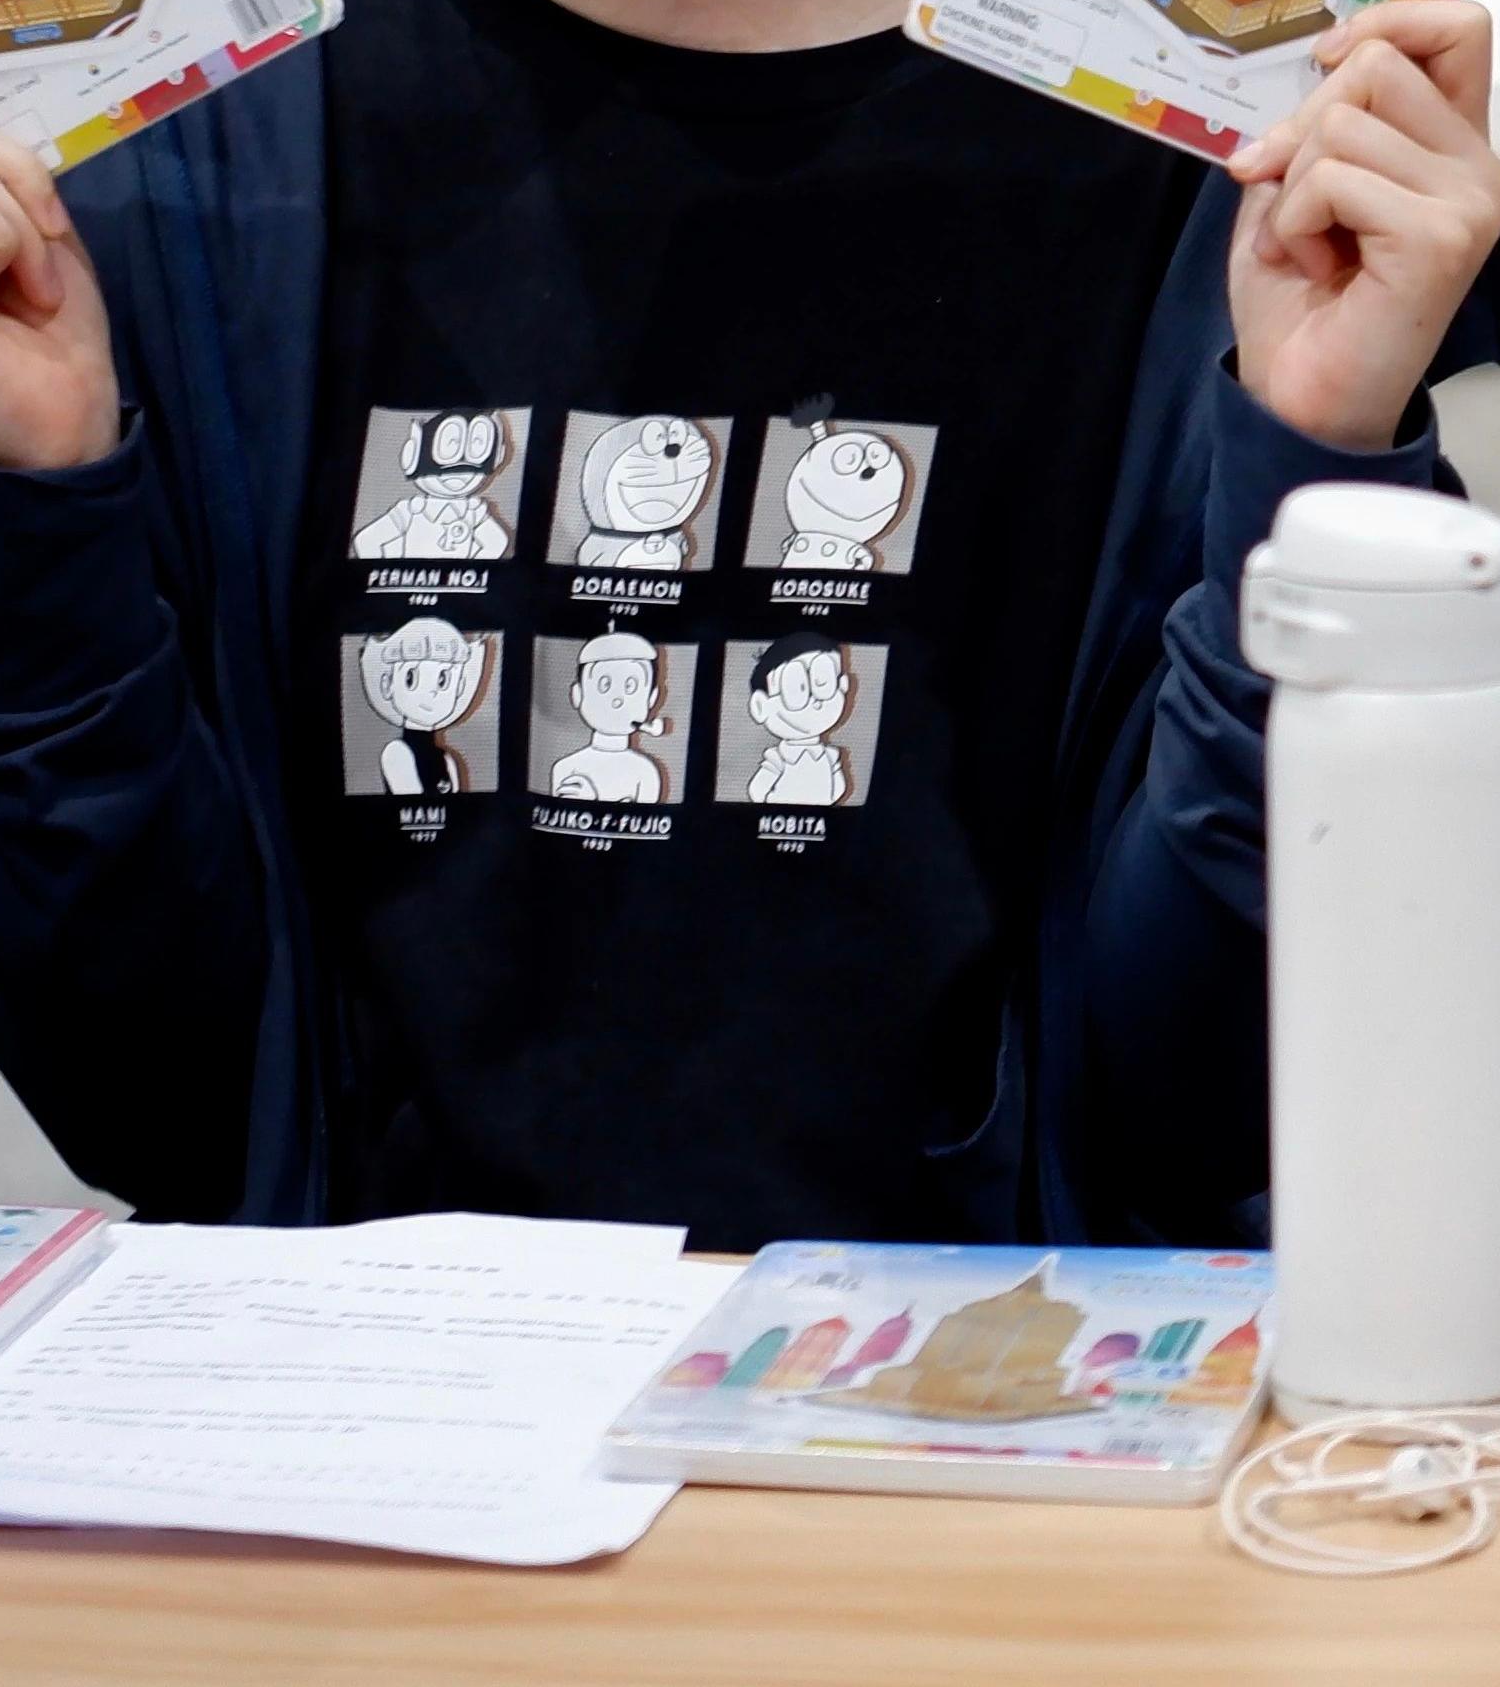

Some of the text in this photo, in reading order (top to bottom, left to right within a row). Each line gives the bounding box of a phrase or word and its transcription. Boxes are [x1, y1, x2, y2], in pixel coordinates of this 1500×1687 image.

[367, 568, 490, 588] PERMAN NO.1
[571, 576, 683, 600] DORAEMON
[770, 578, 872, 600] KOROSUKE
[399, 805, 447, 825] MAMI
[758, 814, 827, 835] NOBITA
